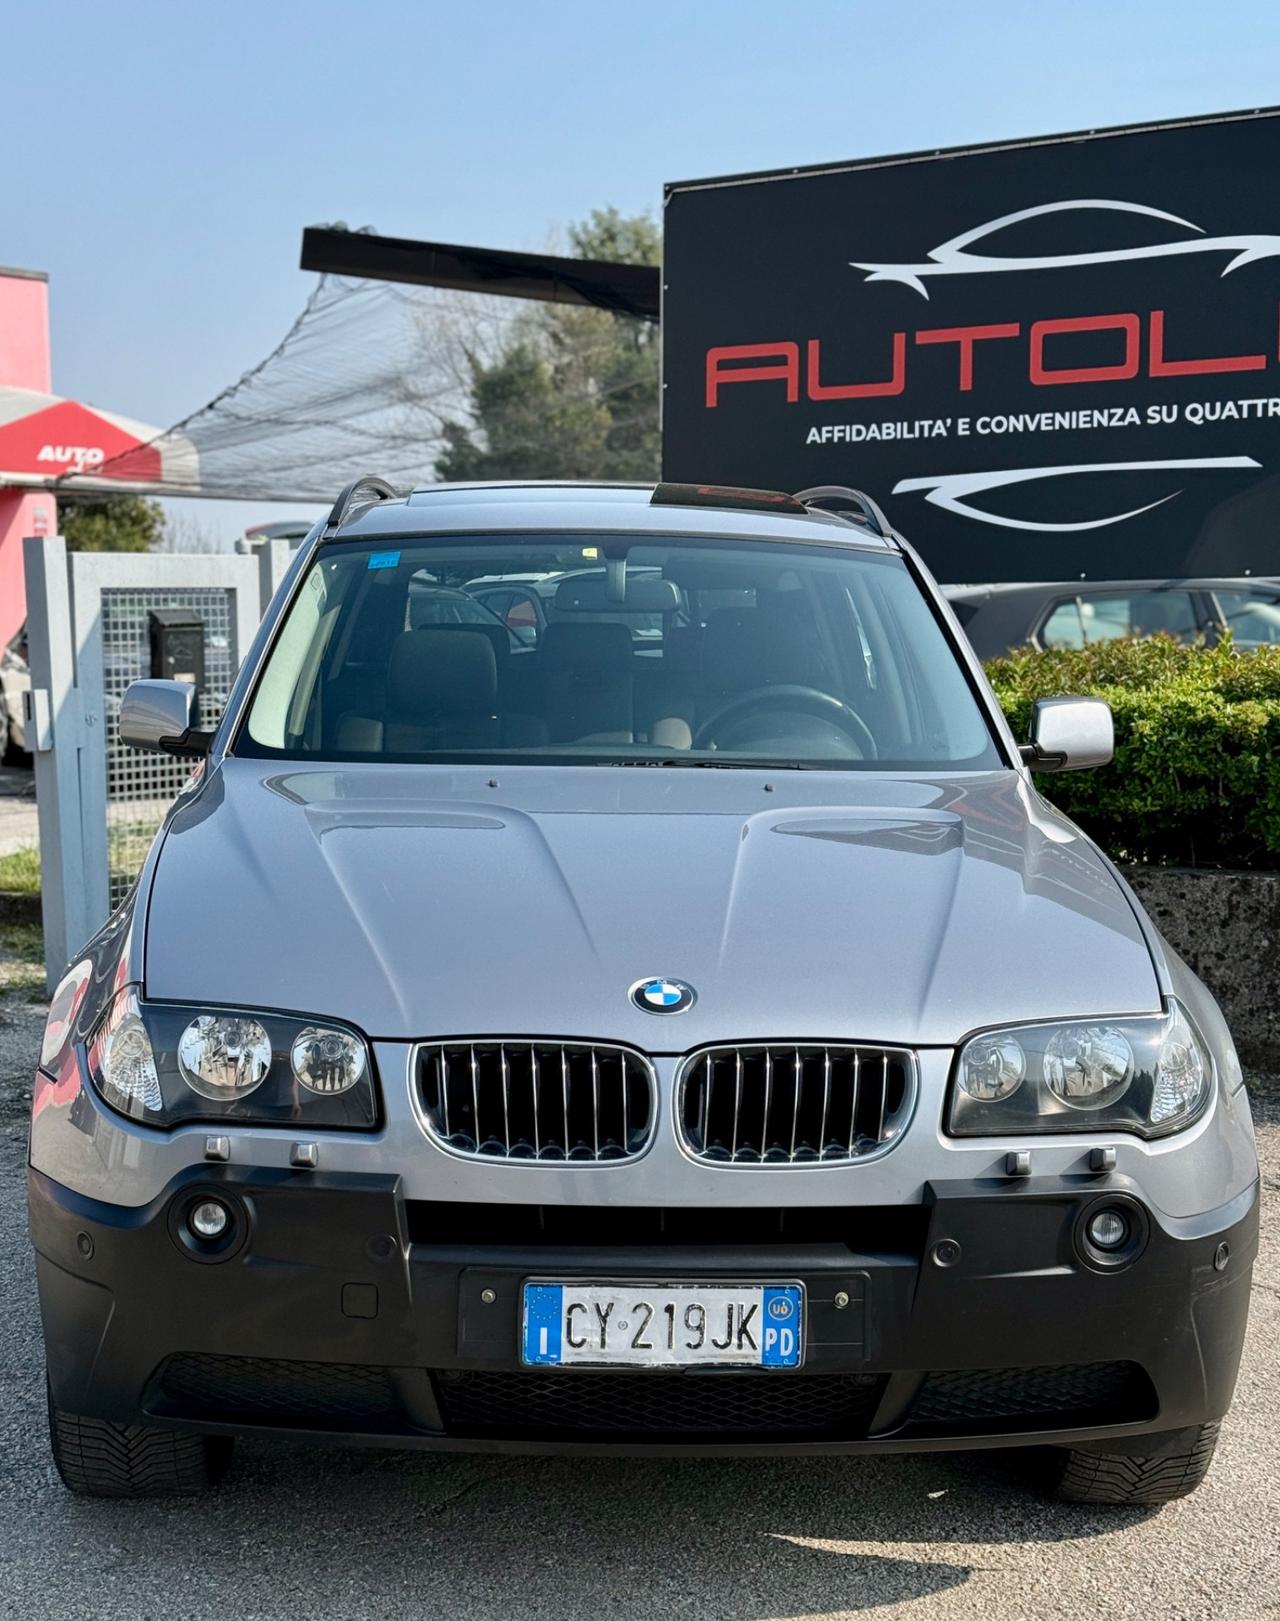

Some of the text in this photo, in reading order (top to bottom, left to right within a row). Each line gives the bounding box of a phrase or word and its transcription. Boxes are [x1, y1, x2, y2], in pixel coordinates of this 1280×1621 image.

[706, 304, 1280, 407] AUTOL
[957, 418, 971, 436] E
[975, 408, 1141, 435] CONVENIENZA
[1146, 405, 1178, 425] SU
[37, 445, 104, 464] AUTO
[566, 1302, 614, 1350] CY
[765, 1327, 794, 1356] PD
